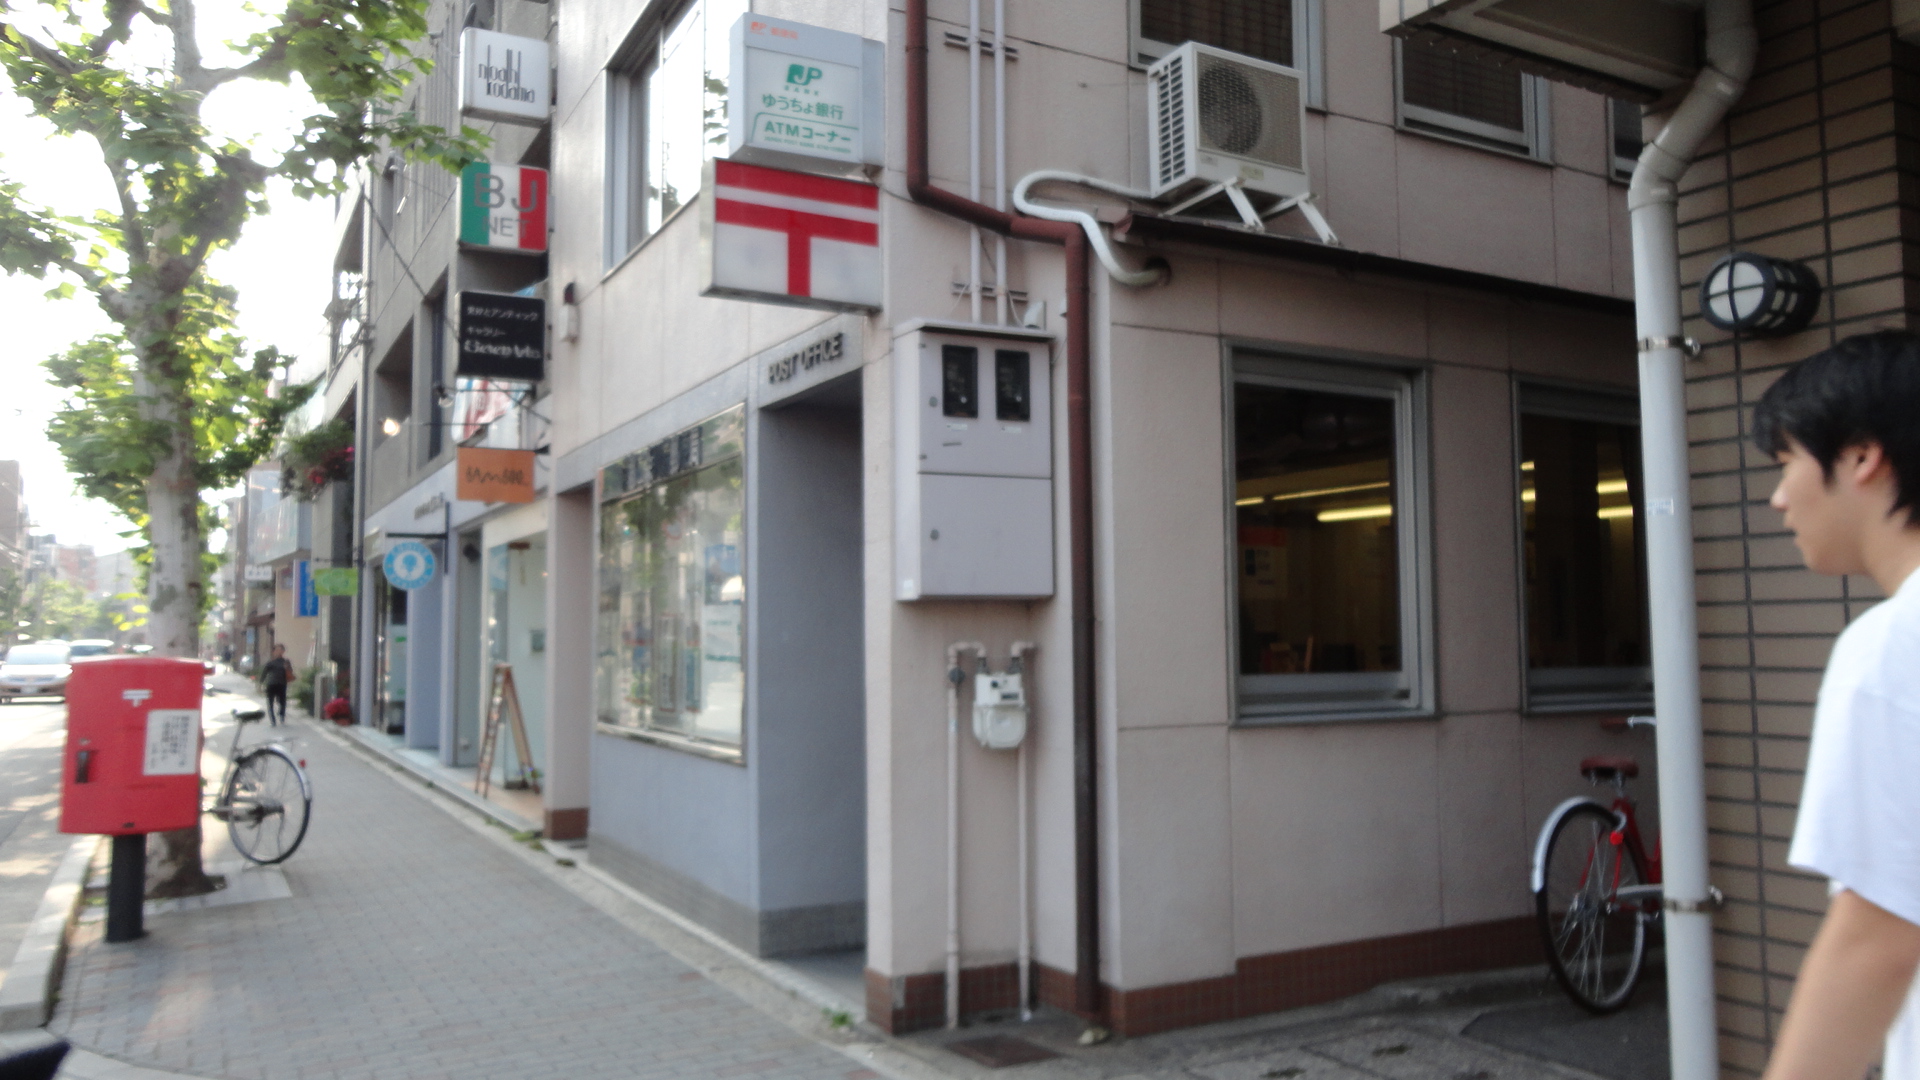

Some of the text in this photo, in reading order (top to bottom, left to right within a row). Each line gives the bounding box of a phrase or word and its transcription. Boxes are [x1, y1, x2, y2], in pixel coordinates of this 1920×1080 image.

[786, 64, 822, 86] JP
[784, 86, 819, 96] BANK
[762, 94, 843, 120] ゆうちょ銀行
[765, 121, 851, 142] ATMコーナー
[474, 173, 537, 212] BJ
[482, 216, 530, 238] NET
[768, 333, 843, 384] POST OFFICE
